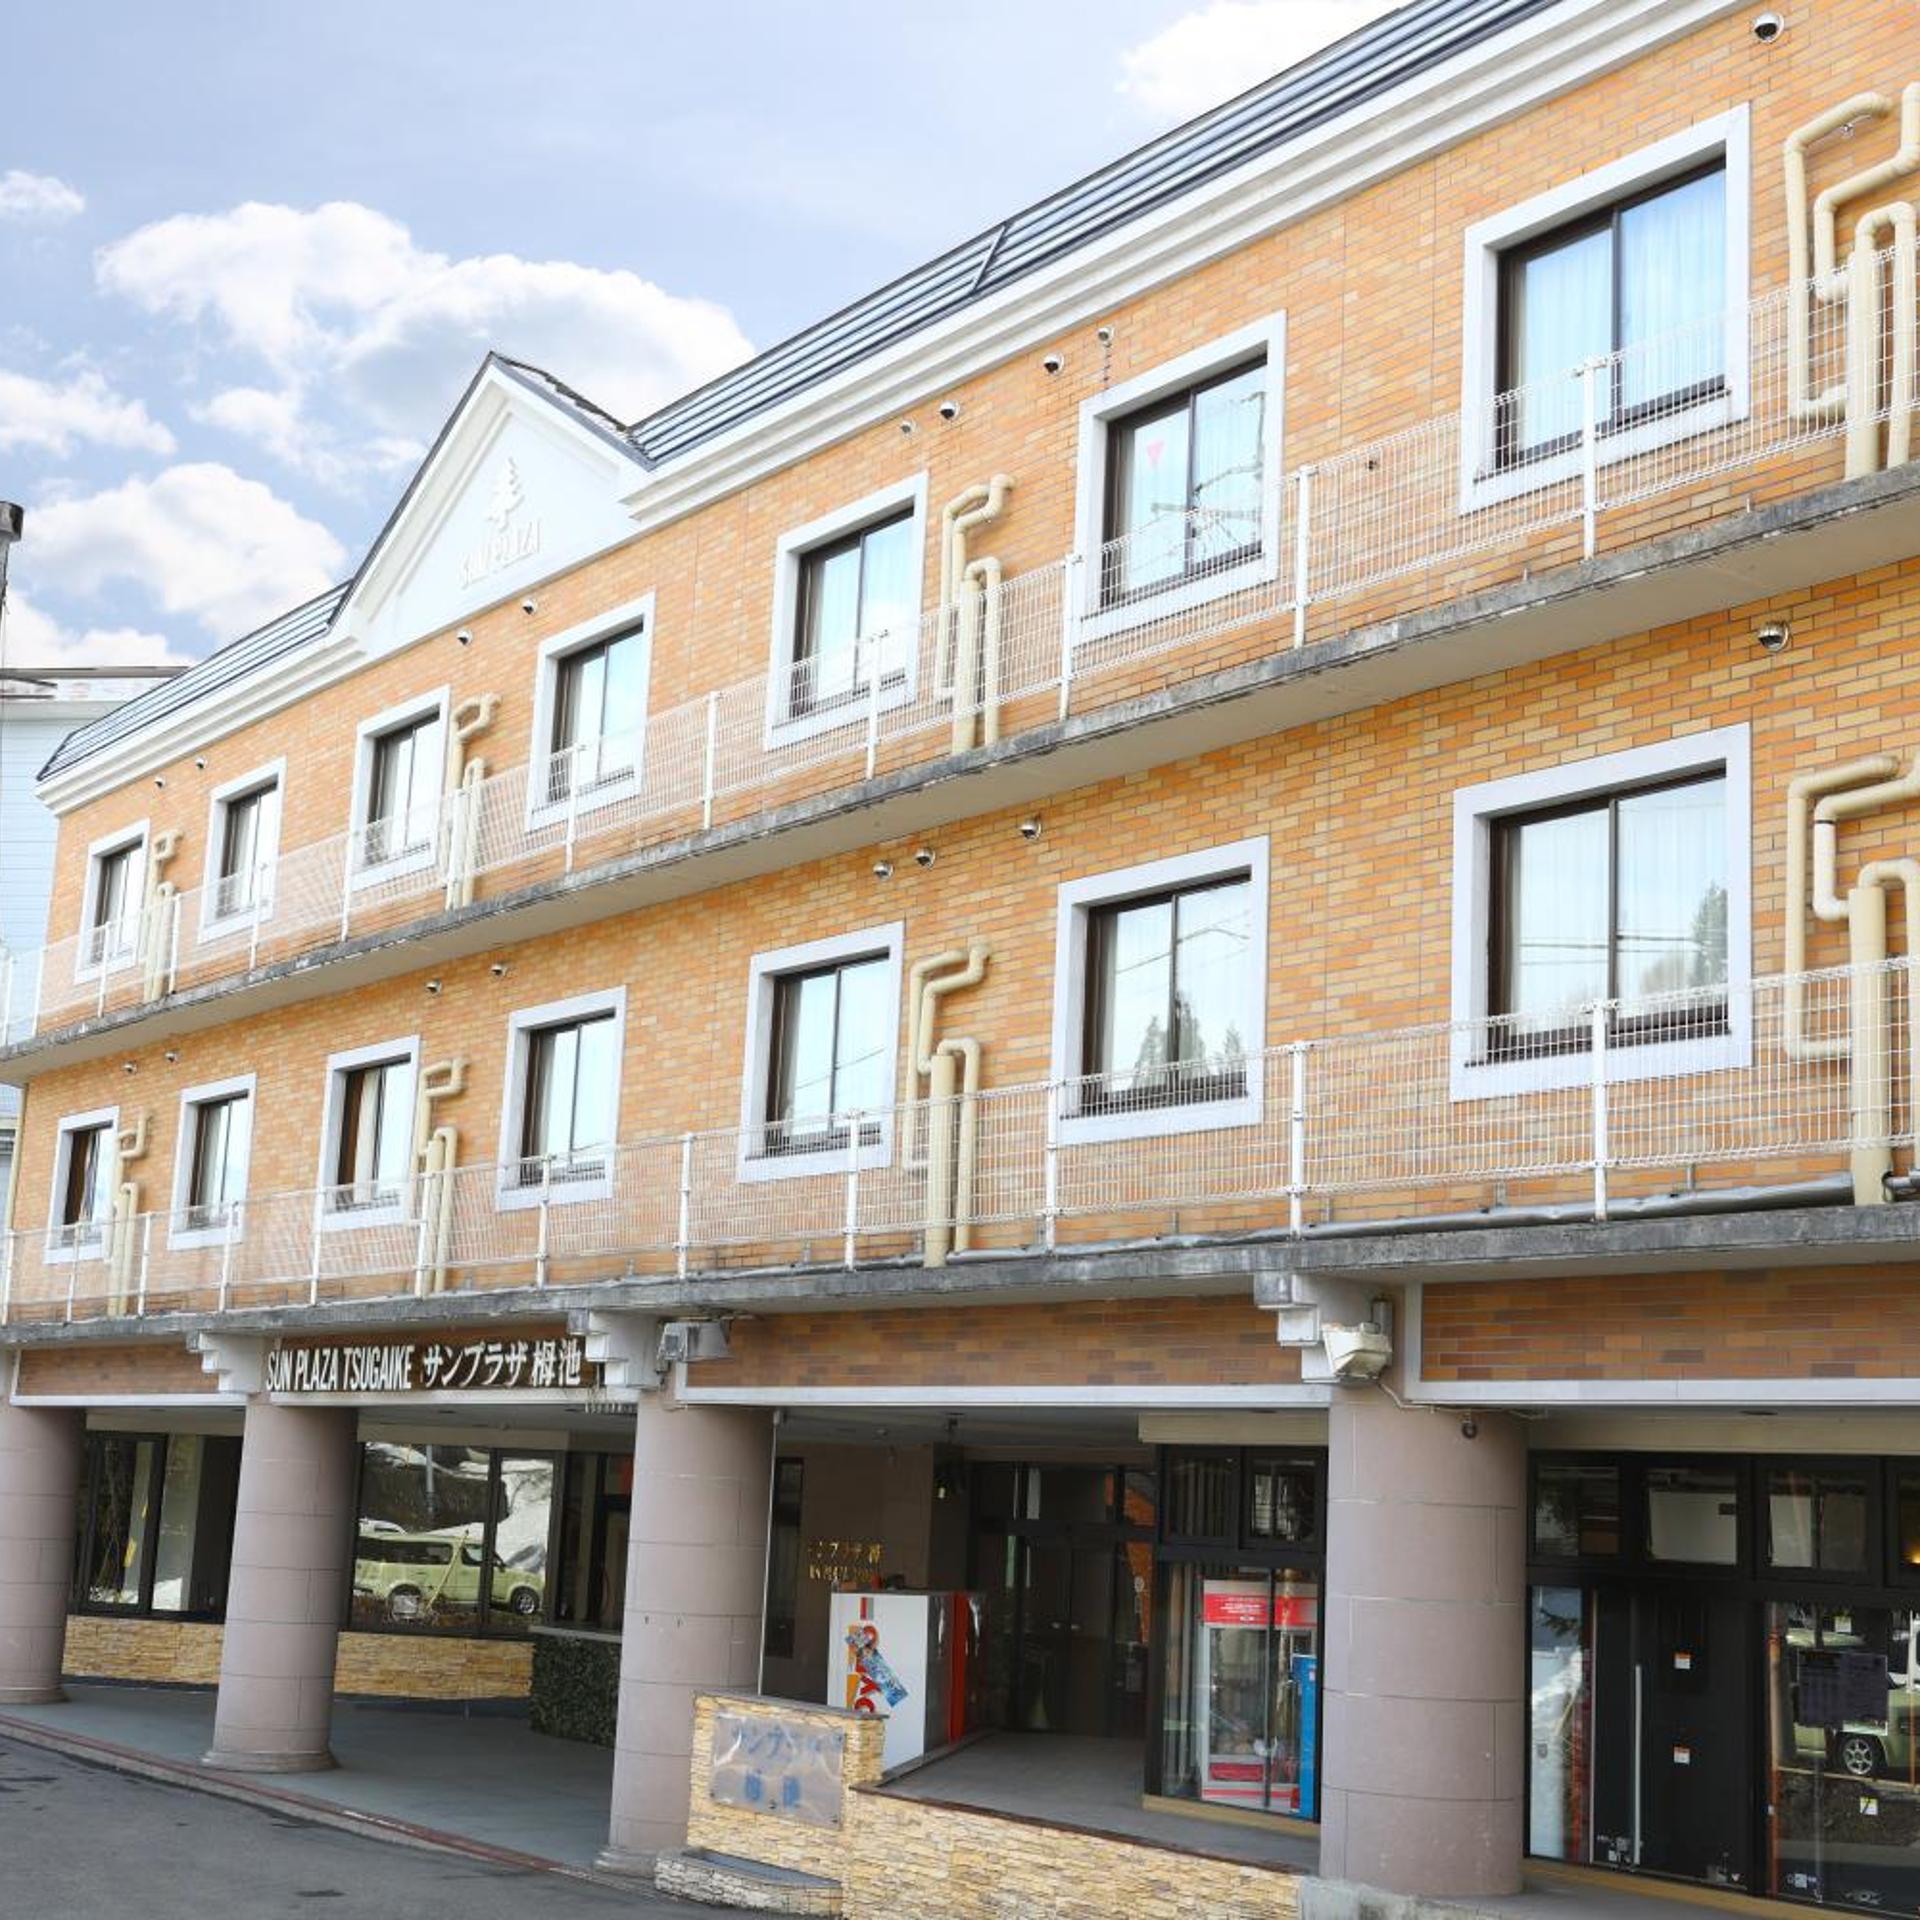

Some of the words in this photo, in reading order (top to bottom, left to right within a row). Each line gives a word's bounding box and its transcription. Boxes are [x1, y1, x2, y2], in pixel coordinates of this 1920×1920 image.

[266, 1350, 293, 1391] SUN
[294, 1348, 338, 1391] PLAZA
[343, 1344, 415, 1391] TSUGAIKE
